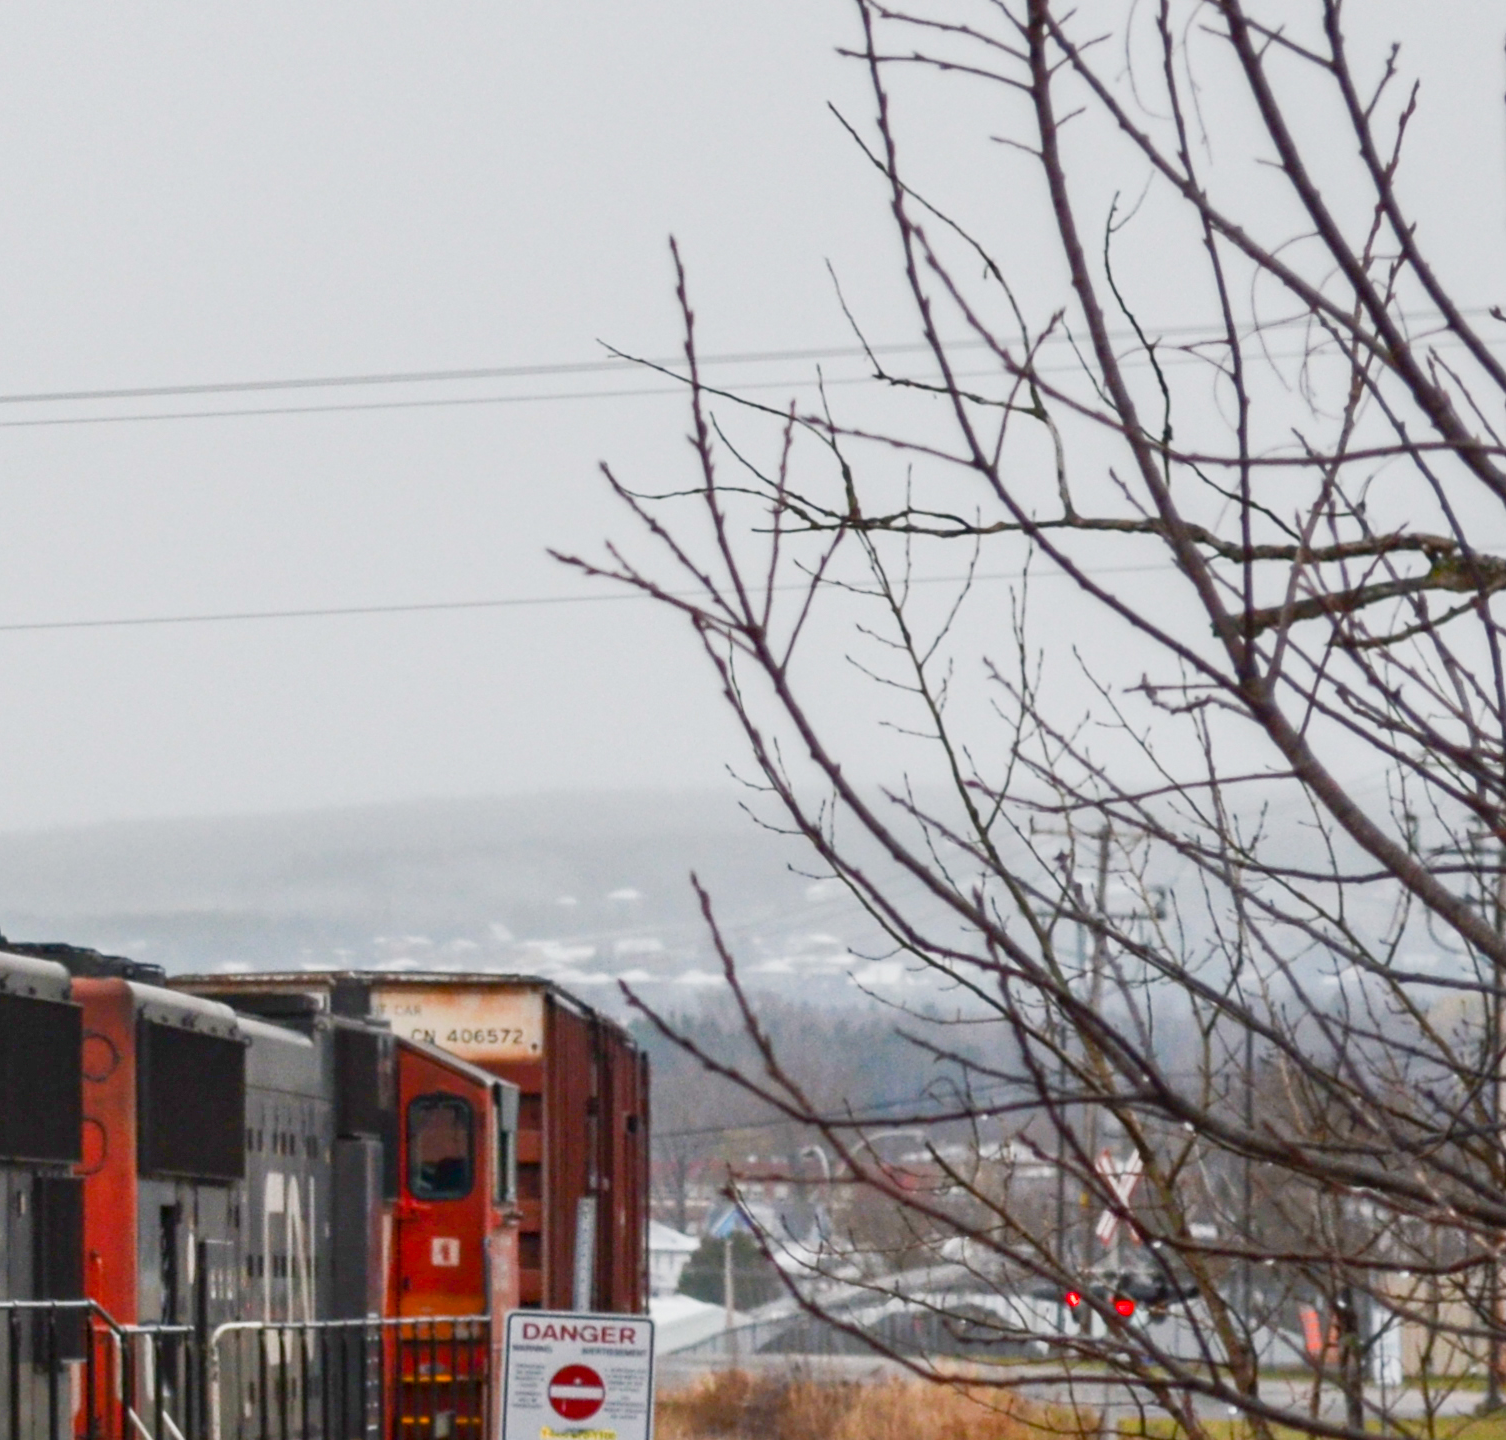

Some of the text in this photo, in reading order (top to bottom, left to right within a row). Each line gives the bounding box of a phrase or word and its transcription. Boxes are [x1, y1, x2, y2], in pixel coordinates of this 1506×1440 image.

[411, 1027, 524, 1045] CN 406572
[264, 1172, 316, 1366] CN
[522, 1322, 637, 1344] DANGER
